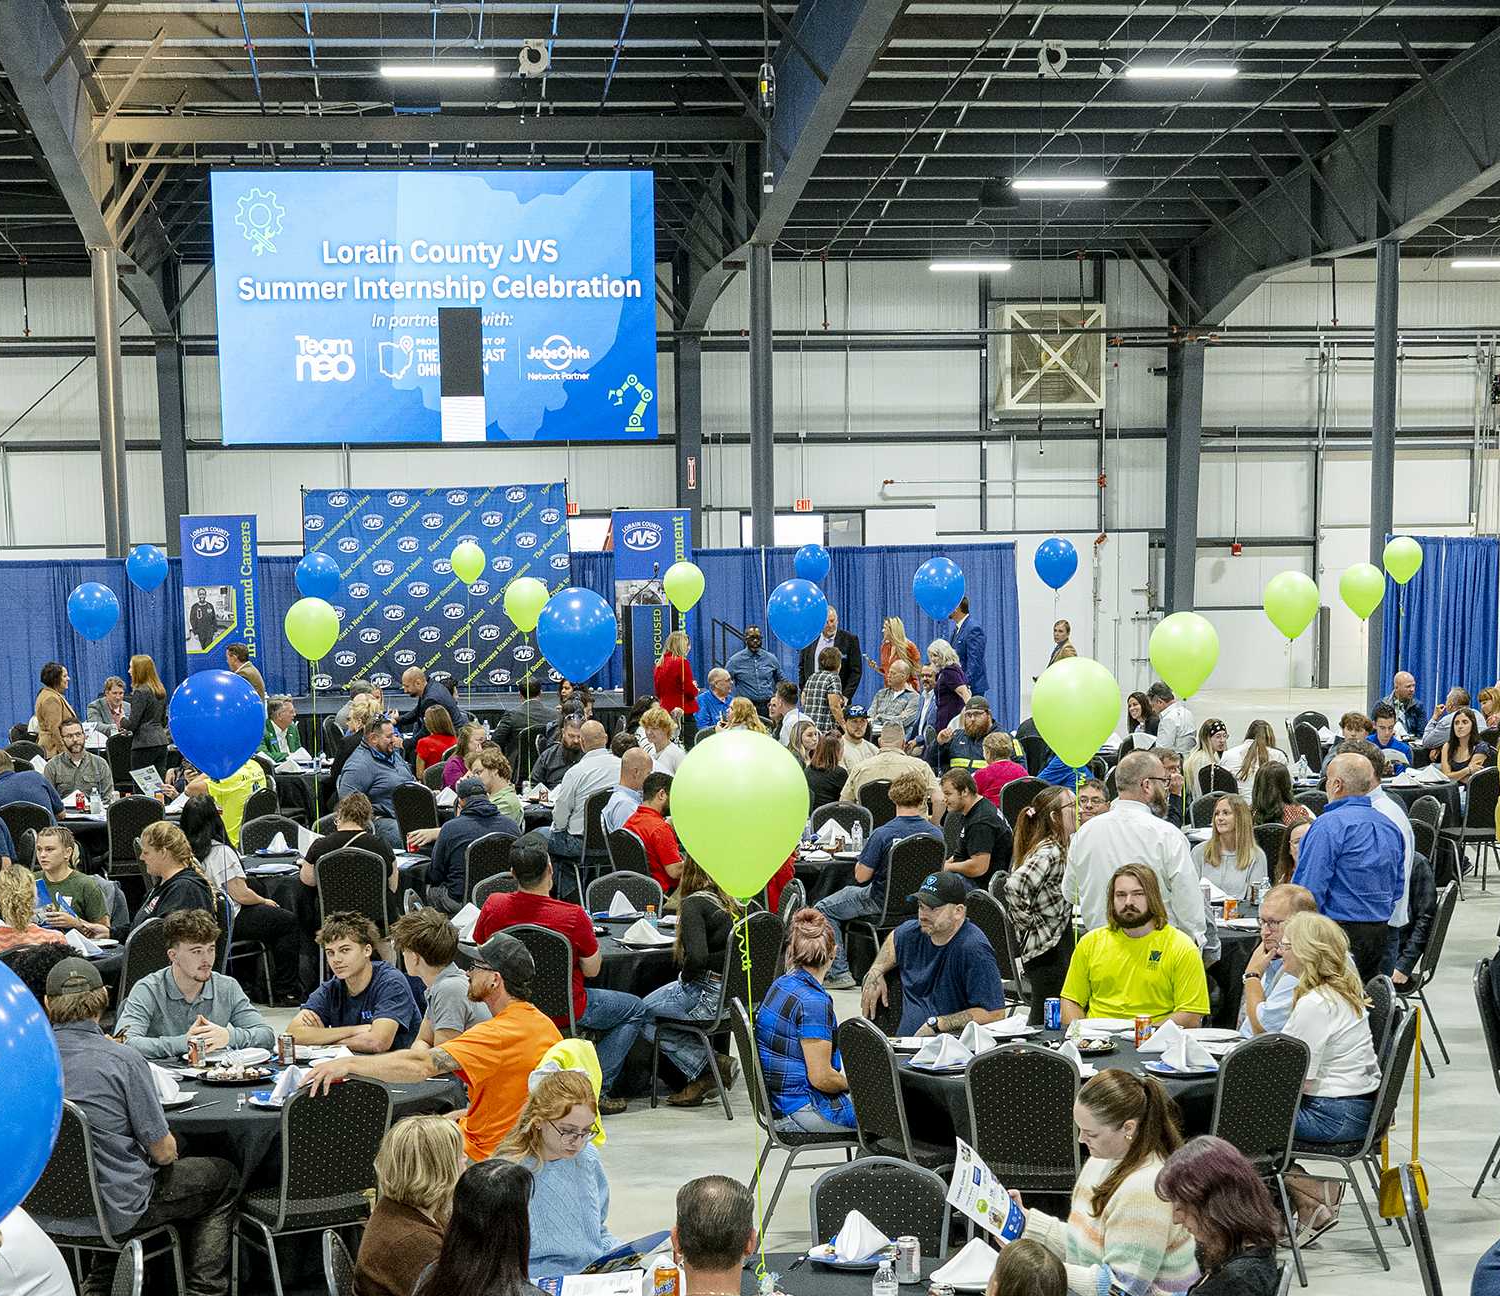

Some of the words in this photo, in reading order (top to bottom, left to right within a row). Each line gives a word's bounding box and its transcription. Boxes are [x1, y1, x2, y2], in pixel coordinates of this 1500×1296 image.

[323, 239, 403, 264] Lorain
[411, 239, 503, 269] County
[510, 239, 558, 264] JVS
[238, 276, 347, 300] Summer
[354, 275, 486, 304] Internship
[492, 275, 641, 300] Celebration
[372, 313, 385, 327] In
[295, 335, 352, 355] Team
[416, 338, 439, 346] PROU
[497, 338, 506, 346] OF
[526, 345, 590, 361] JobsOhio
[296, 353, 356, 382] neo
[527, 372, 560, 382] Network
[561, 372, 590, 382] Partner
[567, 503, 578, 514] XIT
[796, 500, 811, 511] EXIT
[196, 535, 225, 551] JVS
[627, 530, 657, 546] JVS
[240, 521, 252, 576] Careers
[351, 614, 364, 627] New
[363, 600, 379, 616] Career
[445, 624, 471, 649] Upskilling
[469, 609, 485, 625] Talent
[653, 608, 662, 652] FOCUSED
[354, 667, 369, 681] Track
[379, 630, 405, 657] In-Demand
[403, 616, 420, 632] Career
[479, 650, 499, 668] Success
[497, 637, 512, 652] Starts
[425, 652, 441, 668] Career
